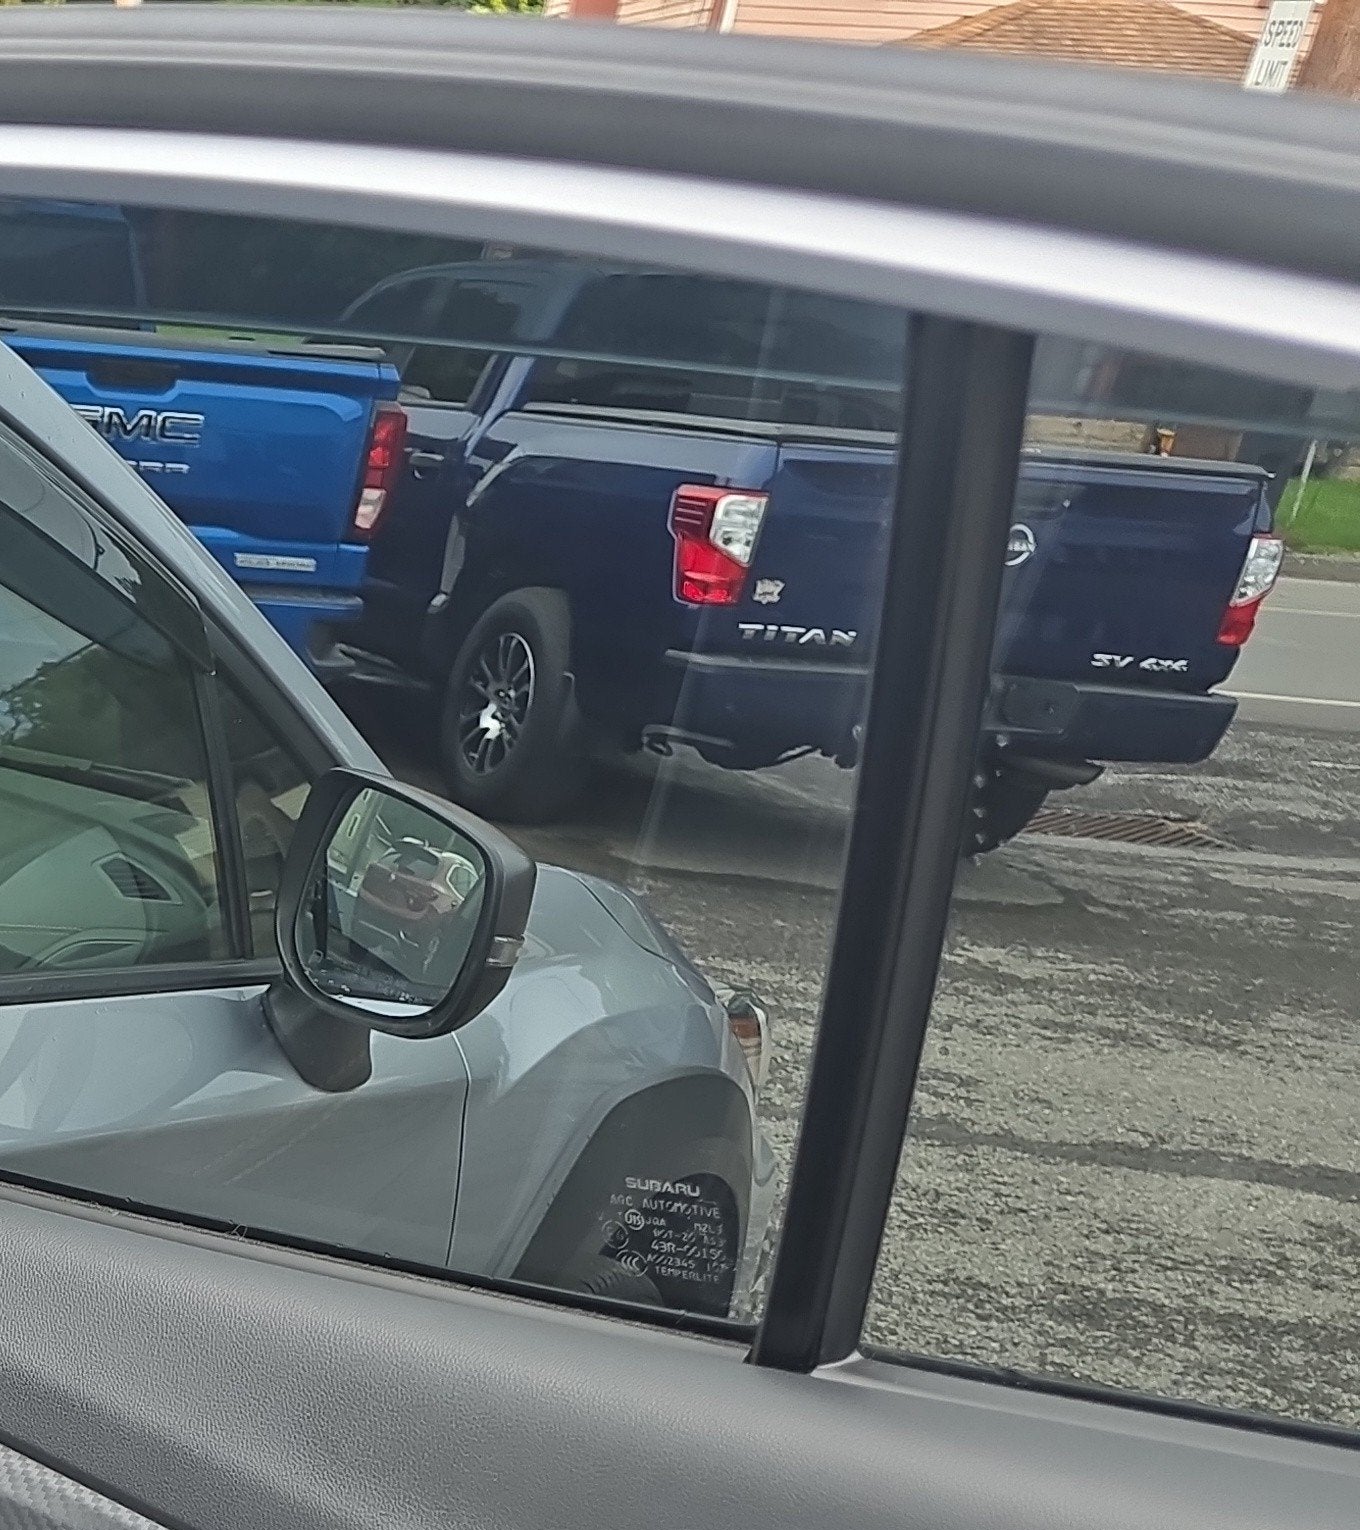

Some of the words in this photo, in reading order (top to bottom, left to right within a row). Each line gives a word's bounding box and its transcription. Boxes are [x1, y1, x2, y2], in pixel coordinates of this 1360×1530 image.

[1264, 20, 1304, 48] SPEED
[1254, 60, 1289, 88] LIMIT
[738, 622, 857, 646] TITAN
[1090, 653, 1134, 668] SV
[625, 1177, 700, 1197] SUBARU
[642, 1198, 721, 1219] AUTOMOTIVE
